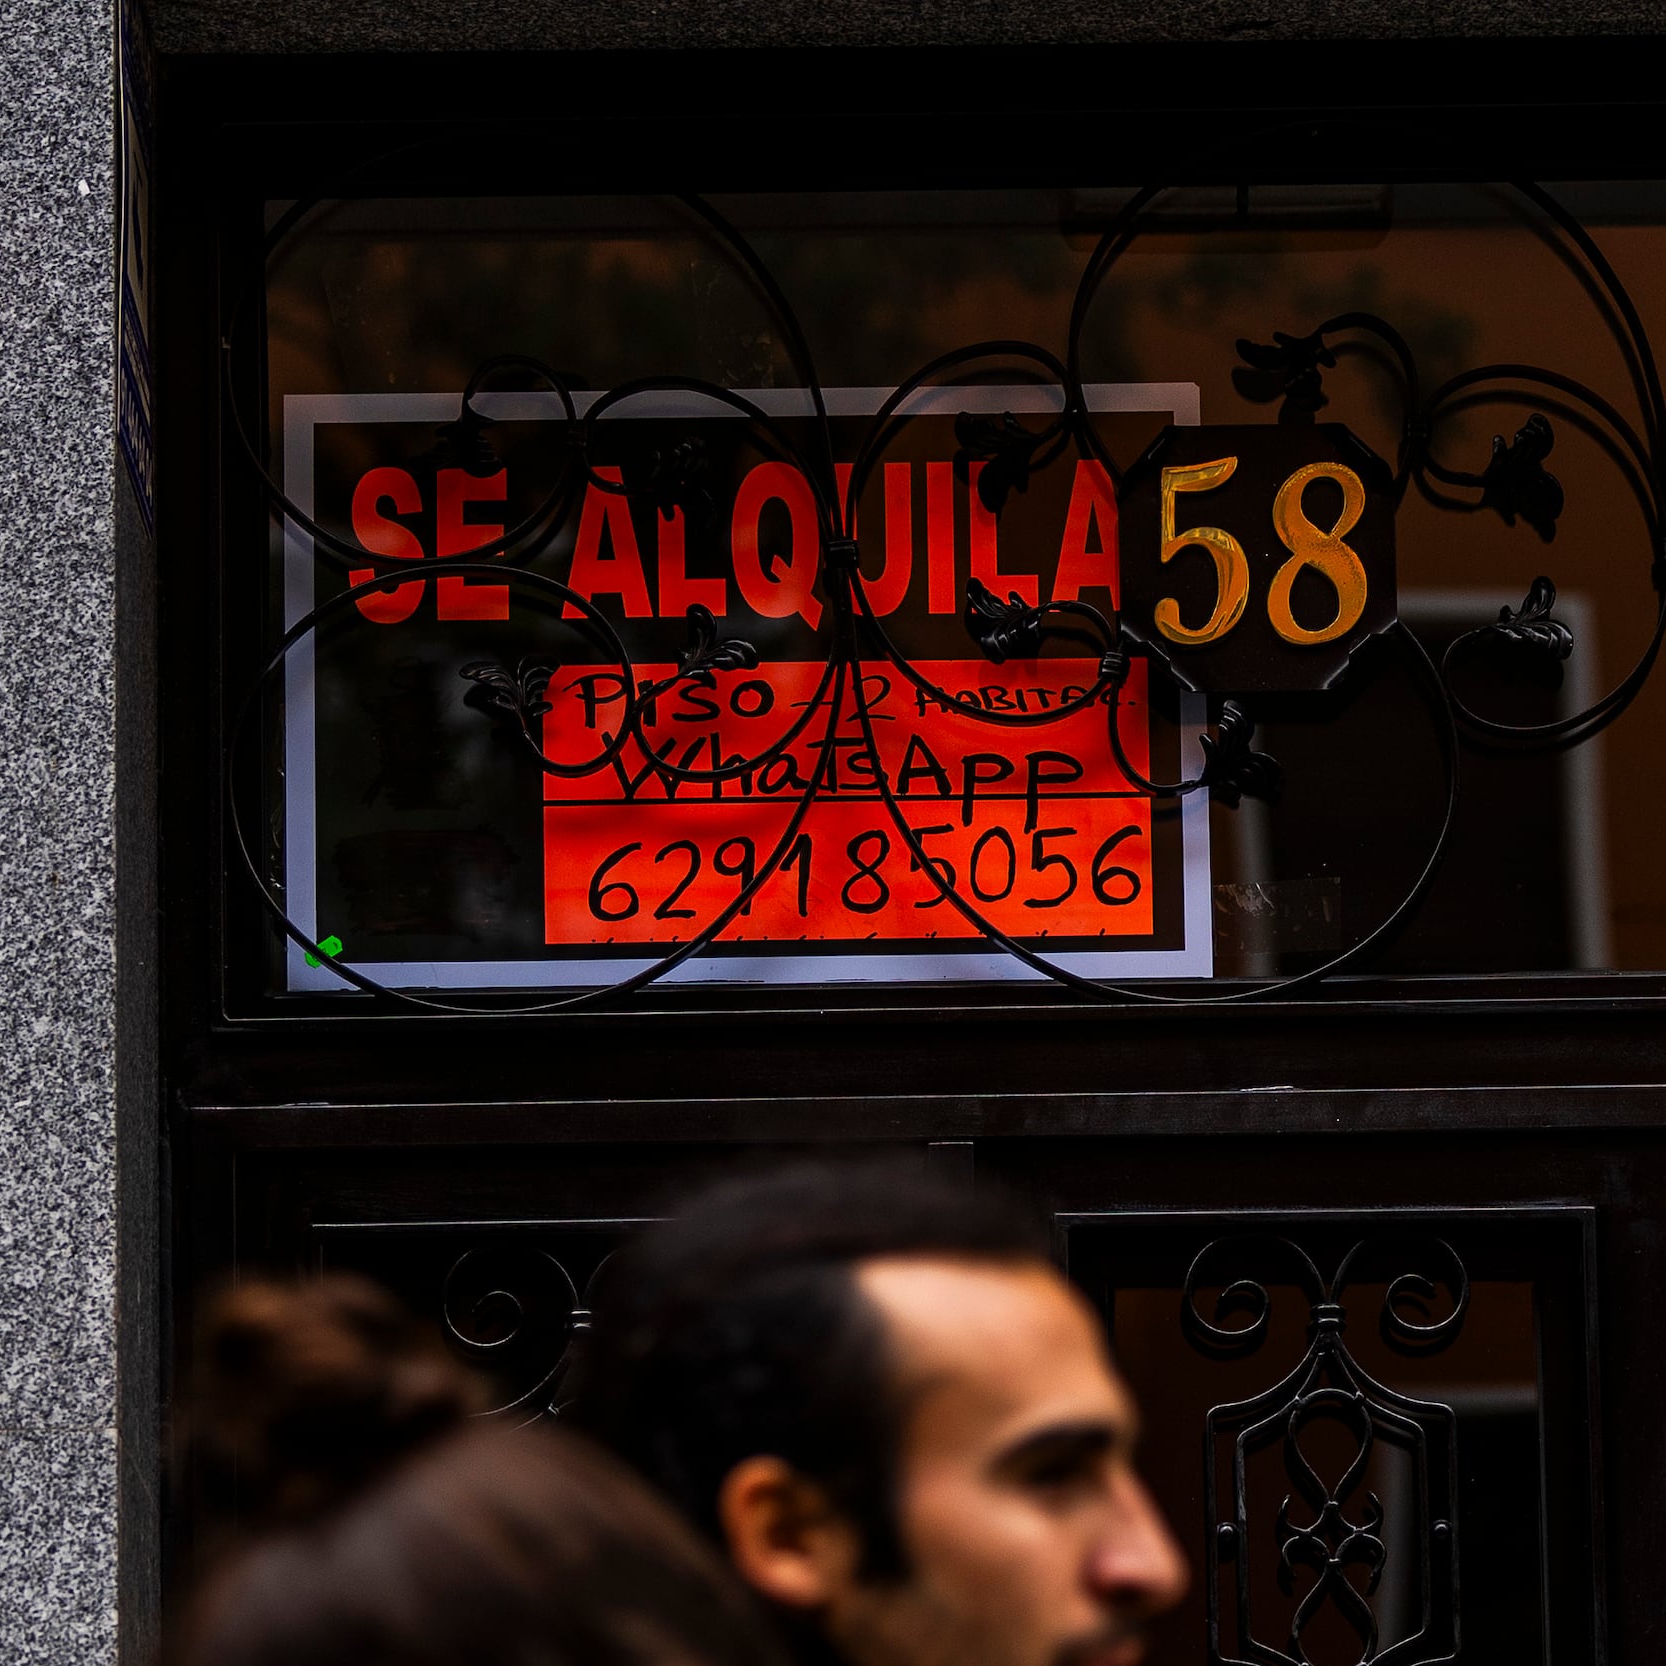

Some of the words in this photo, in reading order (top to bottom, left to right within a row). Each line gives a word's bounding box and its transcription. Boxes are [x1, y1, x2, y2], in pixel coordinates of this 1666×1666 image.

[348, 466, 510, 624] SE
[561, 459, 1121, 632] ALQUILA
[1155, 456, 1367, 645] 58
